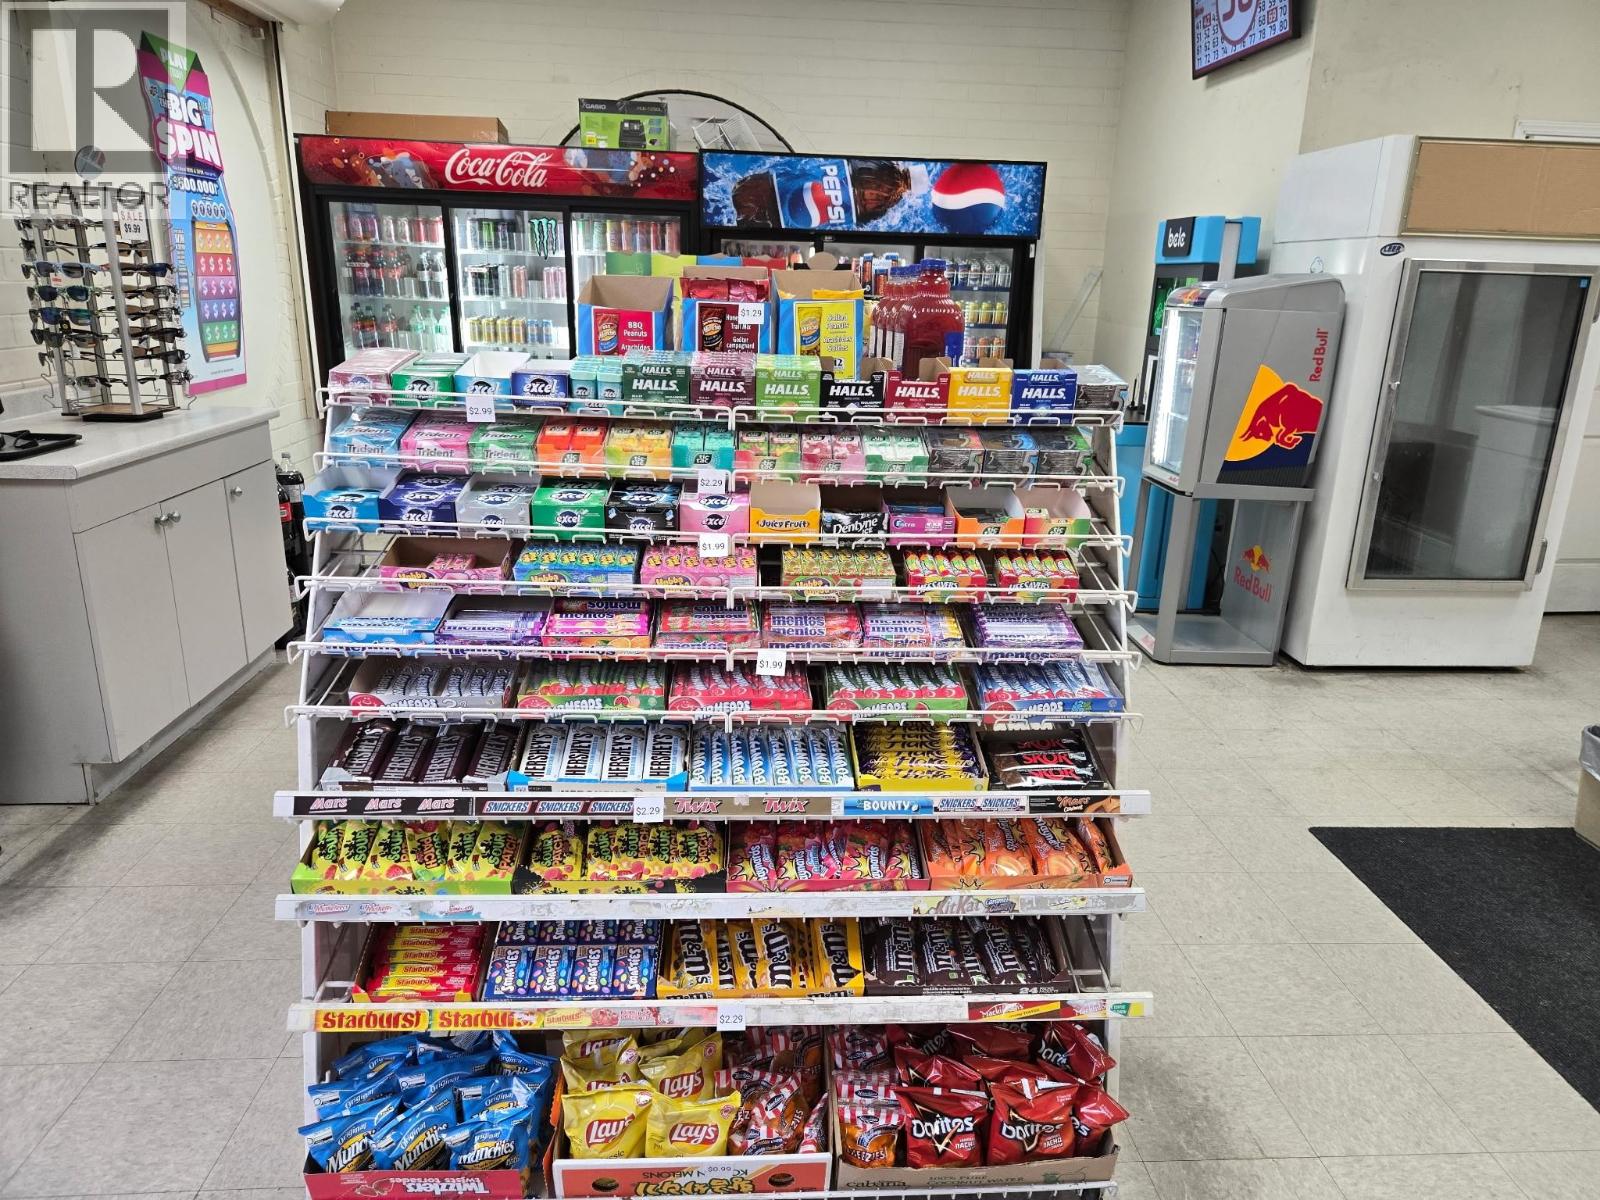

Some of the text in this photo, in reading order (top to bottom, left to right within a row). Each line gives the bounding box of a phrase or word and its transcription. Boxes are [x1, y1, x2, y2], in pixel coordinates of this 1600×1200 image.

[1268, 10, 1277, 22] 69
[1279, 5, 1288, 16] 70
[1212, 24, 1219, 35] 53
[1204, 19, 1288, 63] 72 73 77 78 79 80
[167, 93, 203, 127] BIG
[156, 120, 221, 167] SPIN
[820, 163, 845, 225] PEPSI
[121, 210, 144, 221] SALE
[124, 223, 141, 233] $9.99
[740, 308, 762, 317] $1.29
[628, 321, 643, 330] BBQ
[623, 329, 648, 337] Peanuts
[1309, 330, 1329, 382] Red Bull
[834, 359, 843, 367] 12
[523, 380, 556, 393] excel
[469, 407, 493, 415] $2.99
[347, 444, 384, 454] Trident
[416, 447, 455, 457] Trident
[701, 479, 723, 487] $2.29
[551, 492, 591, 500] excel
[621, 494, 667, 502] excel
[700, 496, 732, 505] excel
[326, 508, 356, 519] excel
[402, 509, 432, 521] excel
[556, 514, 581, 524] excel
[703, 515, 729, 525] excel
[759, 519, 807, 528] Juicy Fruit
[833, 517, 878, 534] Dentyne
[630, 521, 654, 531] excel
[702, 543, 725, 551] $1.99
[1233, 566, 1273, 603] Red Bull
[772, 627, 825, 636] mentos
[871, 625, 924, 633] mentos
[768, 641, 832, 649] mentos
[759, 660, 783, 669] $1.99
[1023, 753, 1073, 765] SKOR
[310, 798, 348, 810] Mars
[364, 798, 402, 810] Mars
[417, 798, 455, 809] Mars
[485, 801, 530, 812] SNICKERS
[537, 801, 582, 812] SNICKERS
[590, 801, 633, 812] SNICKERS
[673, 798, 720, 813] Twix
[763, 798, 808, 812] Twix
[863, 801, 910, 810] BOUNTY
[940, 798, 977, 808] SNICKERS
[981, 798, 1020, 808] SNICKERS
[636, 807, 660, 816] $2.29
[325, 830, 338, 861] SOUR
[354, 830, 369, 862] SOUR
[388, 830, 404, 861] SOUR
[599, 832, 612, 862] SOUR
[627, 829, 639, 858] SOUR
[660, 831, 670, 862] SOUR
[688, 834, 699, 863] SOUR
[423, 837, 438, 869] PATCH
[488, 834, 505, 866] SOUR
[542, 839, 553, 867] SOUR
[403, 965, 438, 973] Starburst
[396, 978, 431, 986] Starburst
[322, 1010, 421, 1028] Starburst
[719, 1014, 743, 1023] $2.29
[430, 1075, 460, 1092] Original
[662, 1072, 703, 1097] Lay's
[345, 1088, 374, 1108] Original
[485, 1092, 513, 1107] Original
[912, 1117, 973, 1138] Doritos
[1002, 1122, 1063, 1140] Doritos
[338, 1122, 367, 1145] Original
[400, 1121, 427, 1149] Original
[671, 1123, 716, 1144] Lay's
[642, 1170, 694, 1179] MELONS
[406, 1181, 490, 1195] Twizzlers
[846, 1180, 906, 1188] cabana
